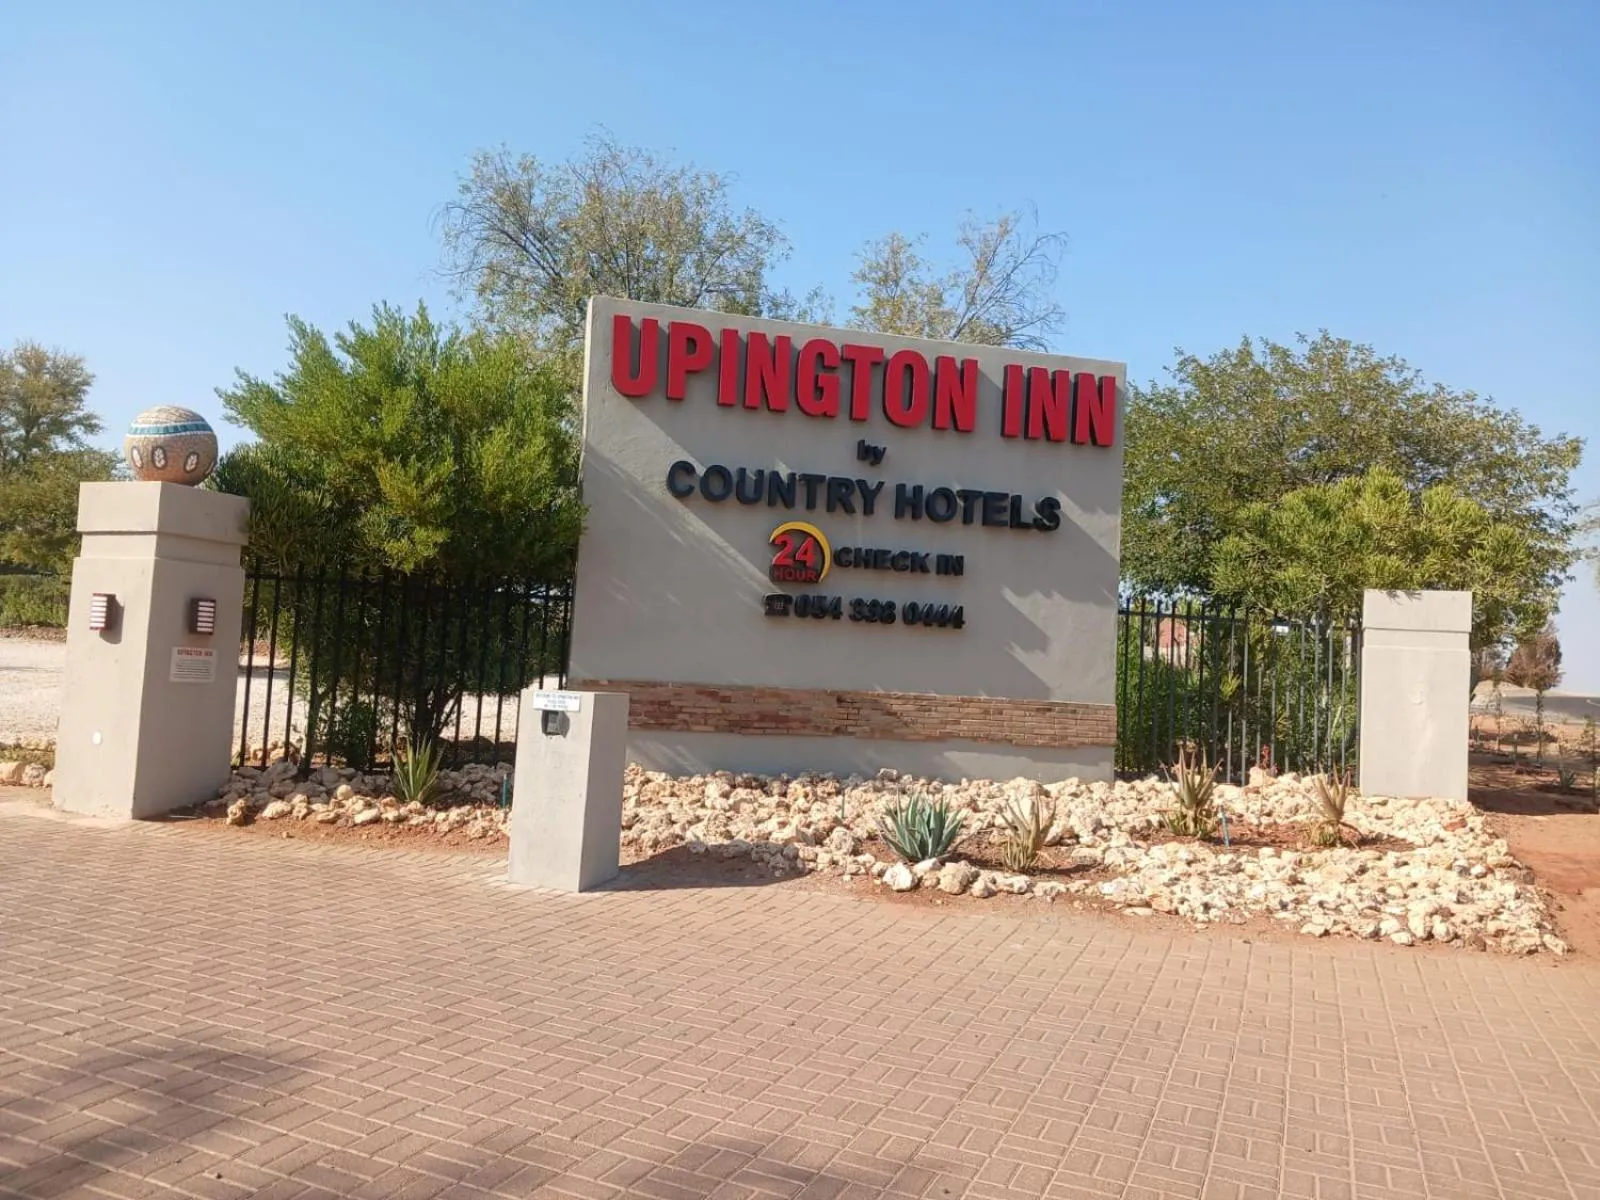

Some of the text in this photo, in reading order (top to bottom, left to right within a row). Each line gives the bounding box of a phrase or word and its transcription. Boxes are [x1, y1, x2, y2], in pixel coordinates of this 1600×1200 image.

[610, 314, 1117, 447] UPINGTON INN
[857, 439, 887, 466] by
[666, 460, 1062, 532] COUNTRY HOTELS
[772, 534, 815, 566] 24
[833, 546, 965, 577] CHECK IN
[773, 567, 818, 582] HOUR
[794, 594, 843, 620] 054
